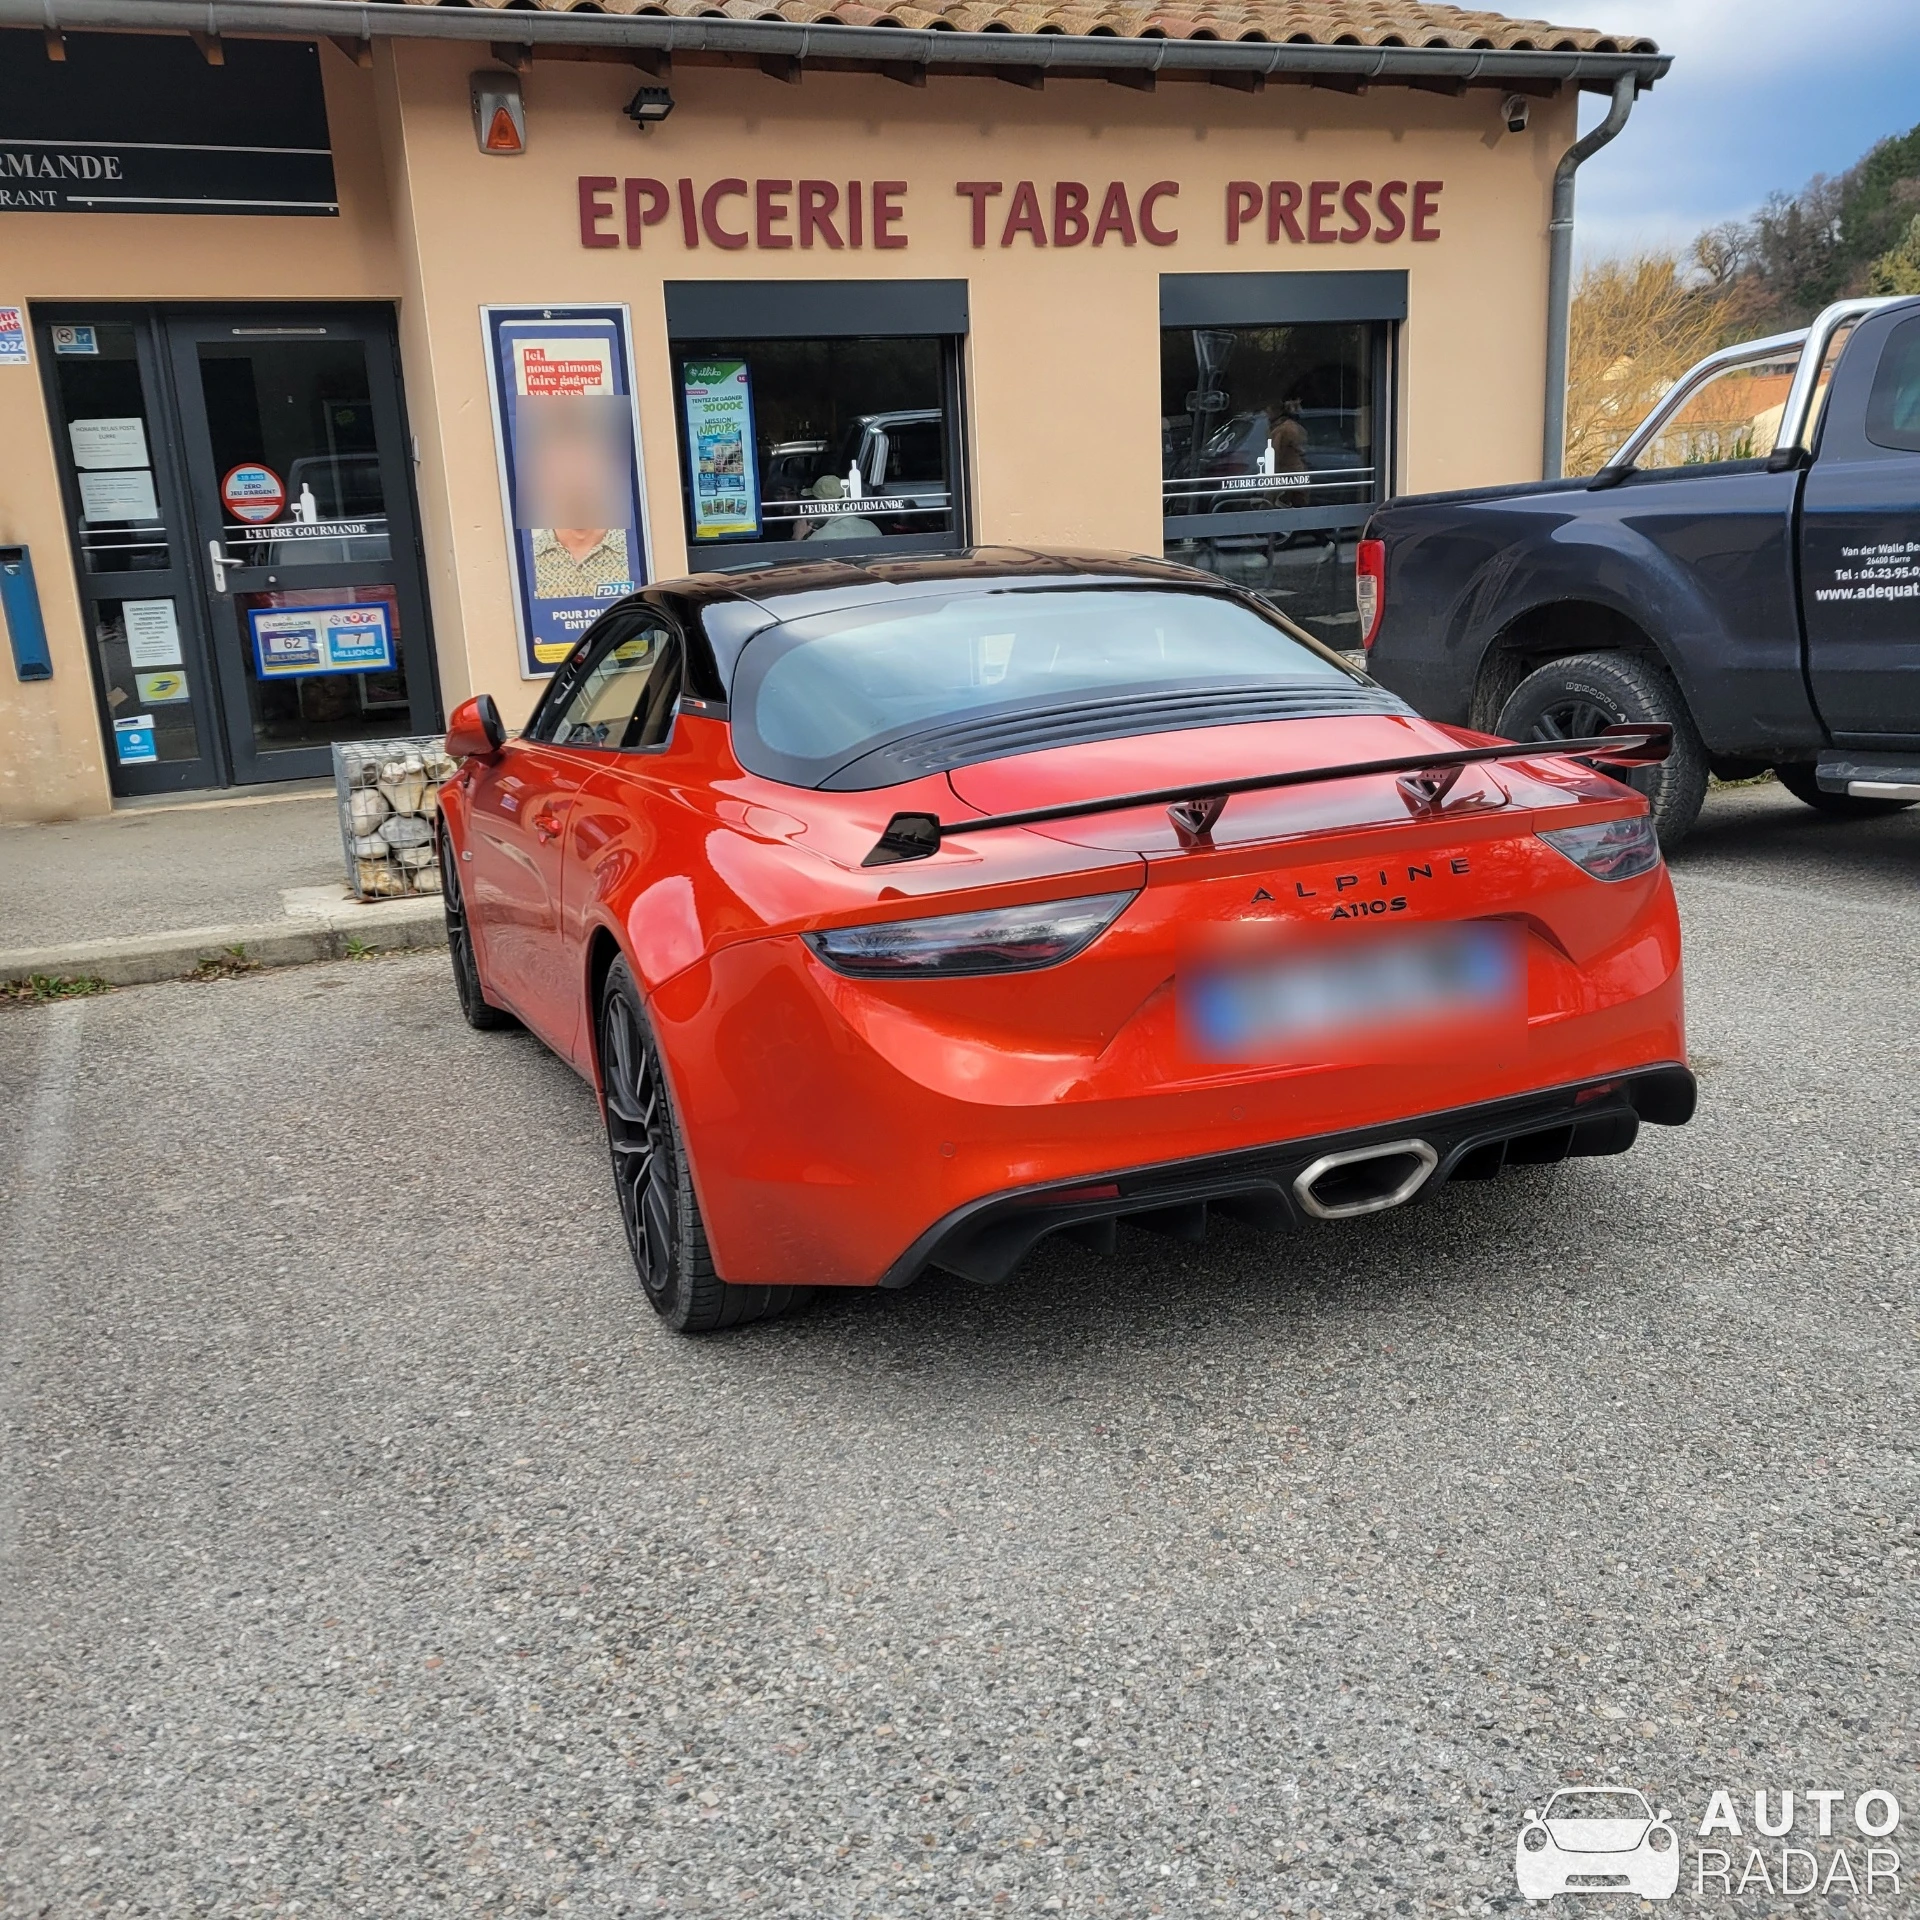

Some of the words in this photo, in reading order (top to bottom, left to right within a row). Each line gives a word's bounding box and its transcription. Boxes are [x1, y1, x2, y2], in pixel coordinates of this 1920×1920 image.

[578, 175, 909, 250] EPICERIE
[956, 179, 1181, 248] TABAC
[1226, 179, 1444, 245] PRESSE
[525, 351, 544, 361] Ici,
[526, 364, 555, 373] nous
[558, 362, 601, 373] aimons
[527, 375, 557, 386] faire
[560, 376, 600, 387] gagner
[703, 404, 715, 412] 30
[705, 417, 731, 425] MISSION
[699, 422, 739, 436] NATURE
[1221, 478, 1256, 489] L'EURRE
[1258, 475, 1310, 486] GOURMANDE
[800, 503, 840, 514] L'EURRE
[843, 499, 905, 511] GOURMANDE
[295, 524, 367, 536] GOURMANDE
[1841, 546, 1859, 556] Van
[1860, 545, 1876, 555] der
[1878, 543, 1905, 553] Walle
[1866, 556, 1889, 565] 26400
[1889, 555, 1911, 564] Eurre
[1835, 569, 1852, 580] Tel
[597, 585, 620, 596] FDJ
[343, 612, 377, 625] LOTO
[552, 610, 583, 620] POUR
[284, 638, 302, 649] 62
[353, 634, 361, 644] 7
[333, 649, 373, 658] MILLIONS
[1250, 858, 1470, 904] ALPINE
[1330, 896, 1408, 920] A110S
